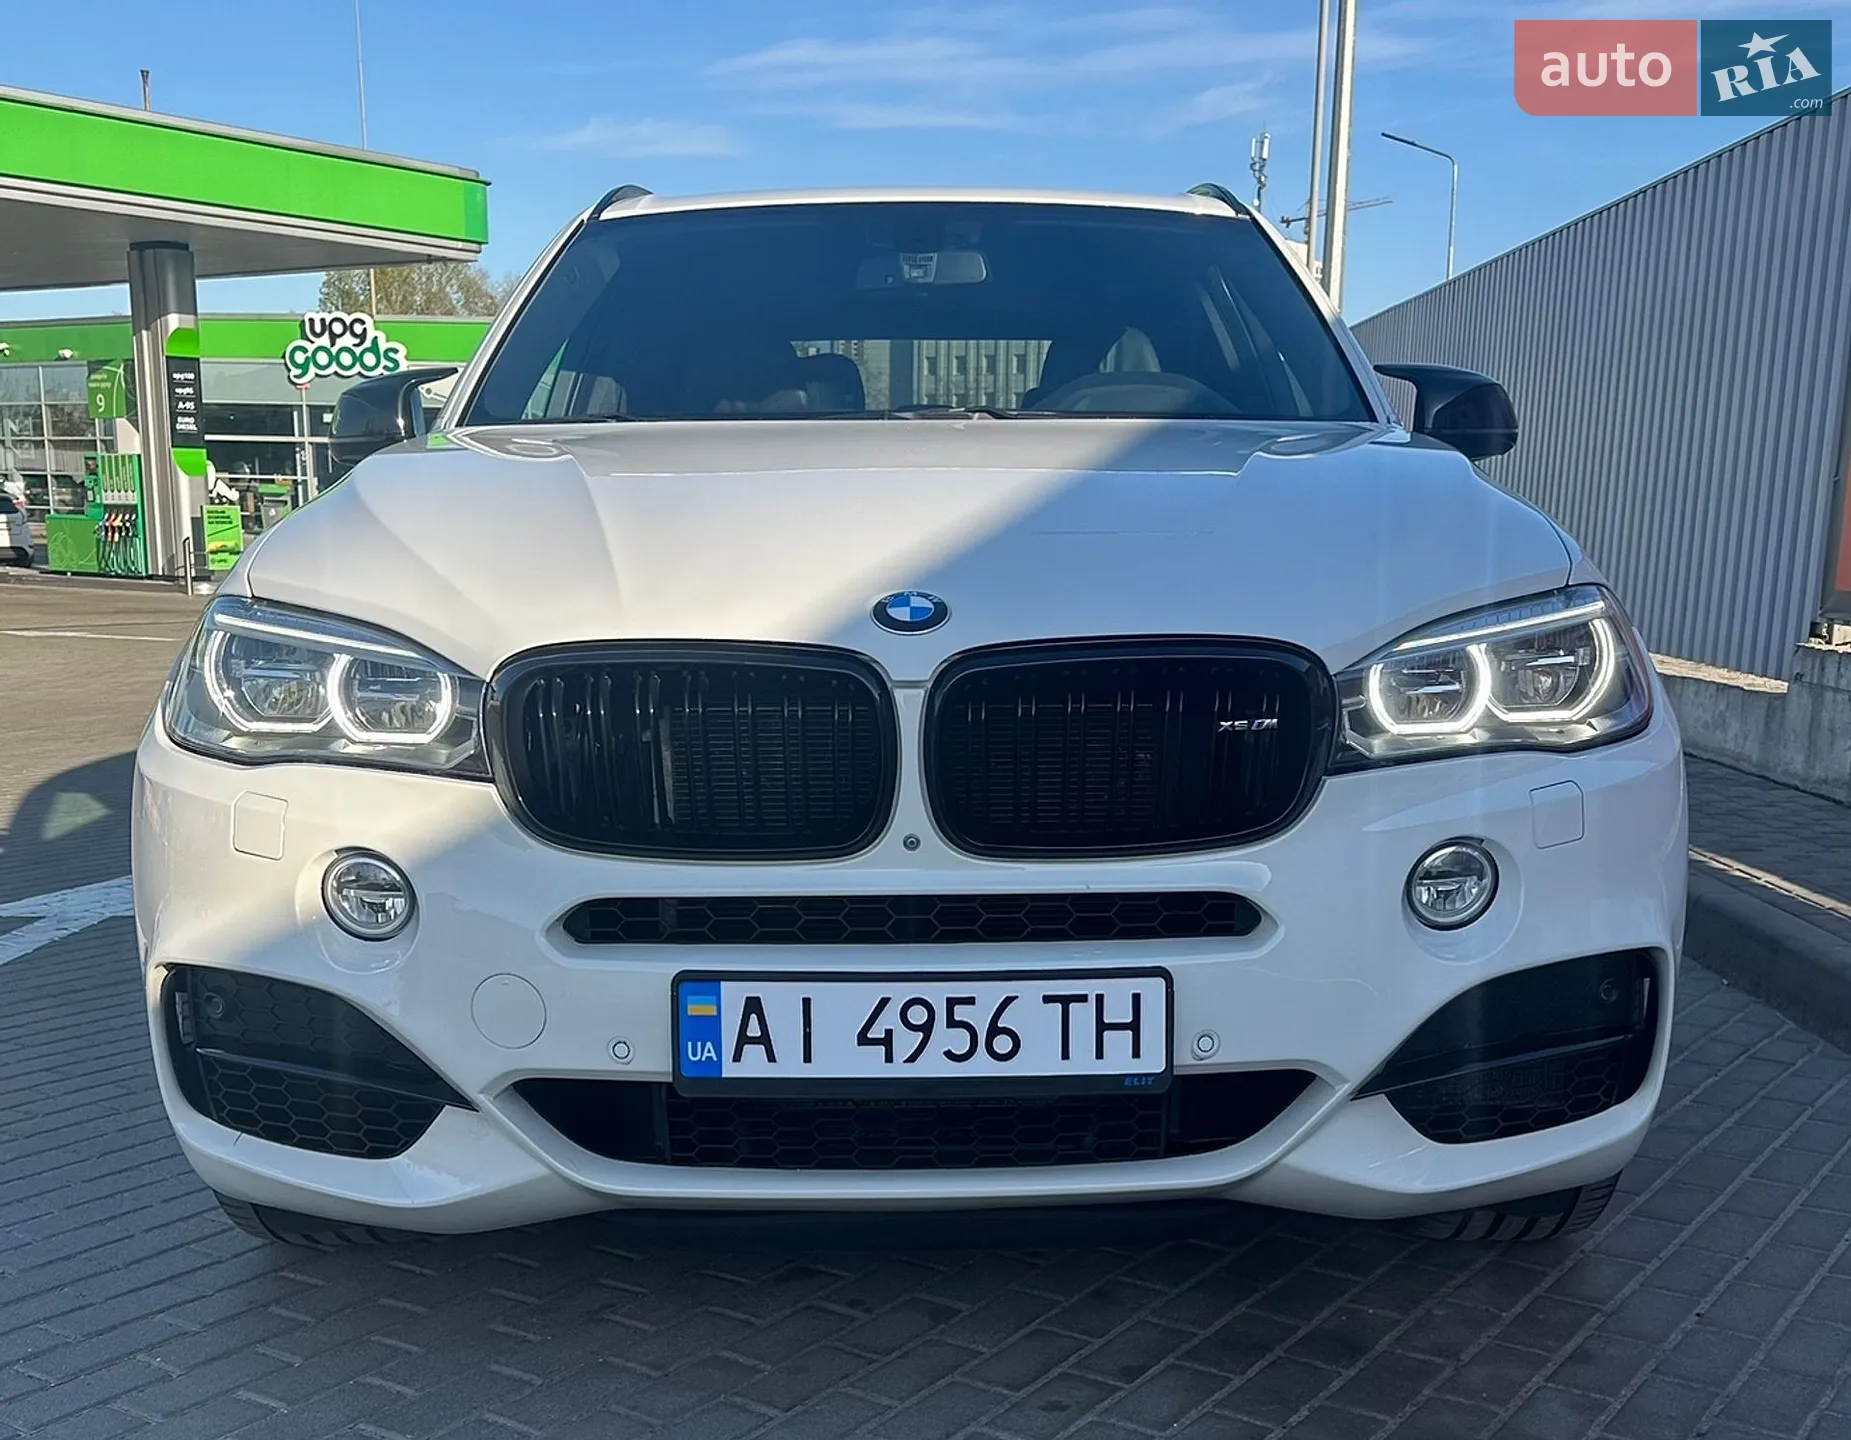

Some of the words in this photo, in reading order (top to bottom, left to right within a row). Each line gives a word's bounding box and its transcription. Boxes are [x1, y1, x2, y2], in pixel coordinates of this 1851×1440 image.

[308, 316, 368, 348] upg
[288, 335, 401, 379] goods
[96, 393, 106, 413] 9
[731, 995, 813, 1064] AI
[856, 995, 1023, 1064] 4956
[1041, 991, 1142, 1061] TH
[686, 1041, 718, 1062] UA
